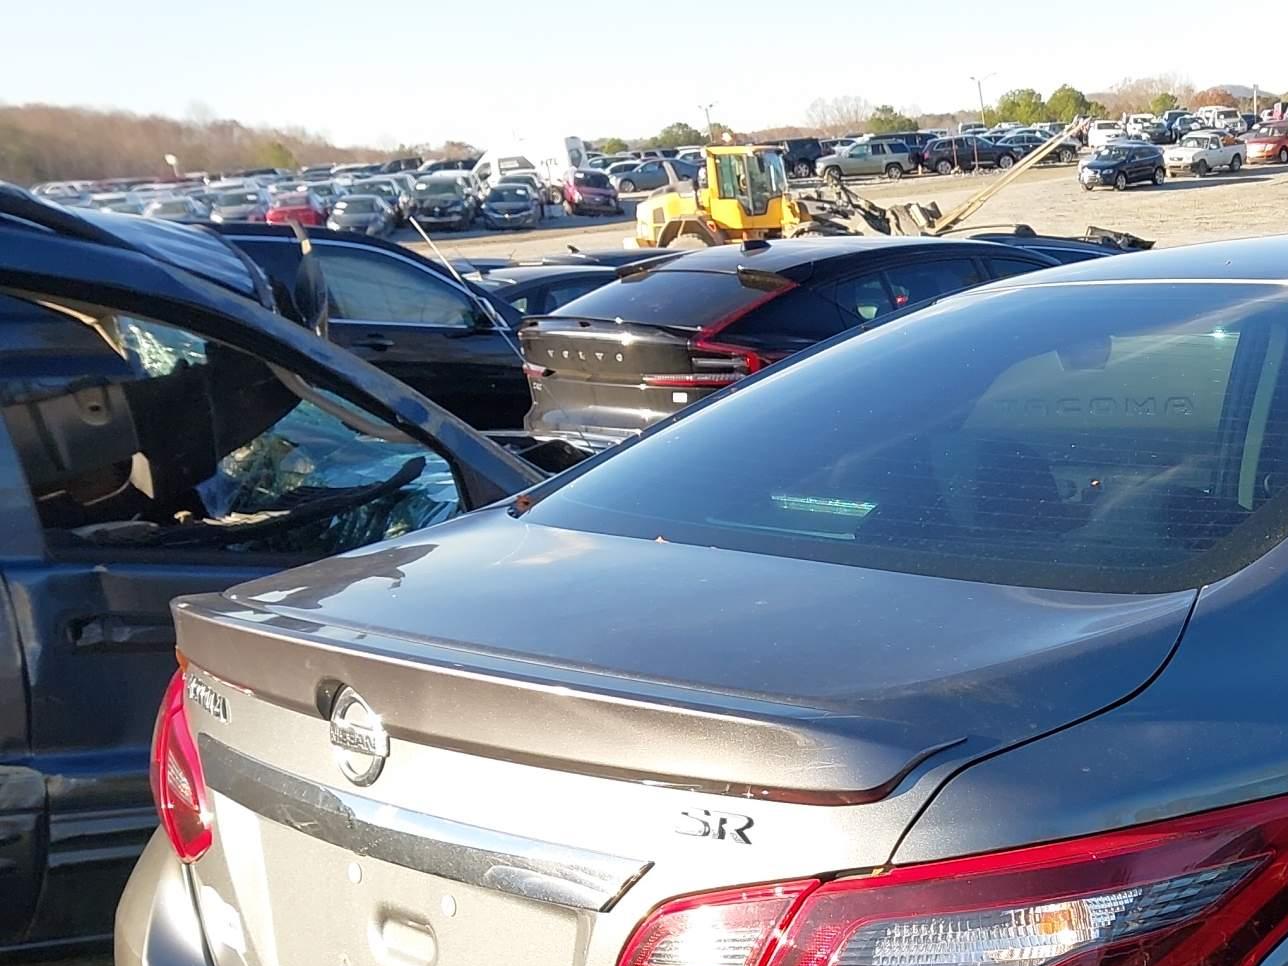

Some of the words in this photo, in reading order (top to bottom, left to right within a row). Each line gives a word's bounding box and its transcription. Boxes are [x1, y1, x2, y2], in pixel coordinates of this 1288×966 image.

[547, 349, 624, 363] VOLVO
[994, 396, 1194, 416] TACOMA
[331, 724, 377, 753] NISSAN
[674, 807, 755, 845] SR
